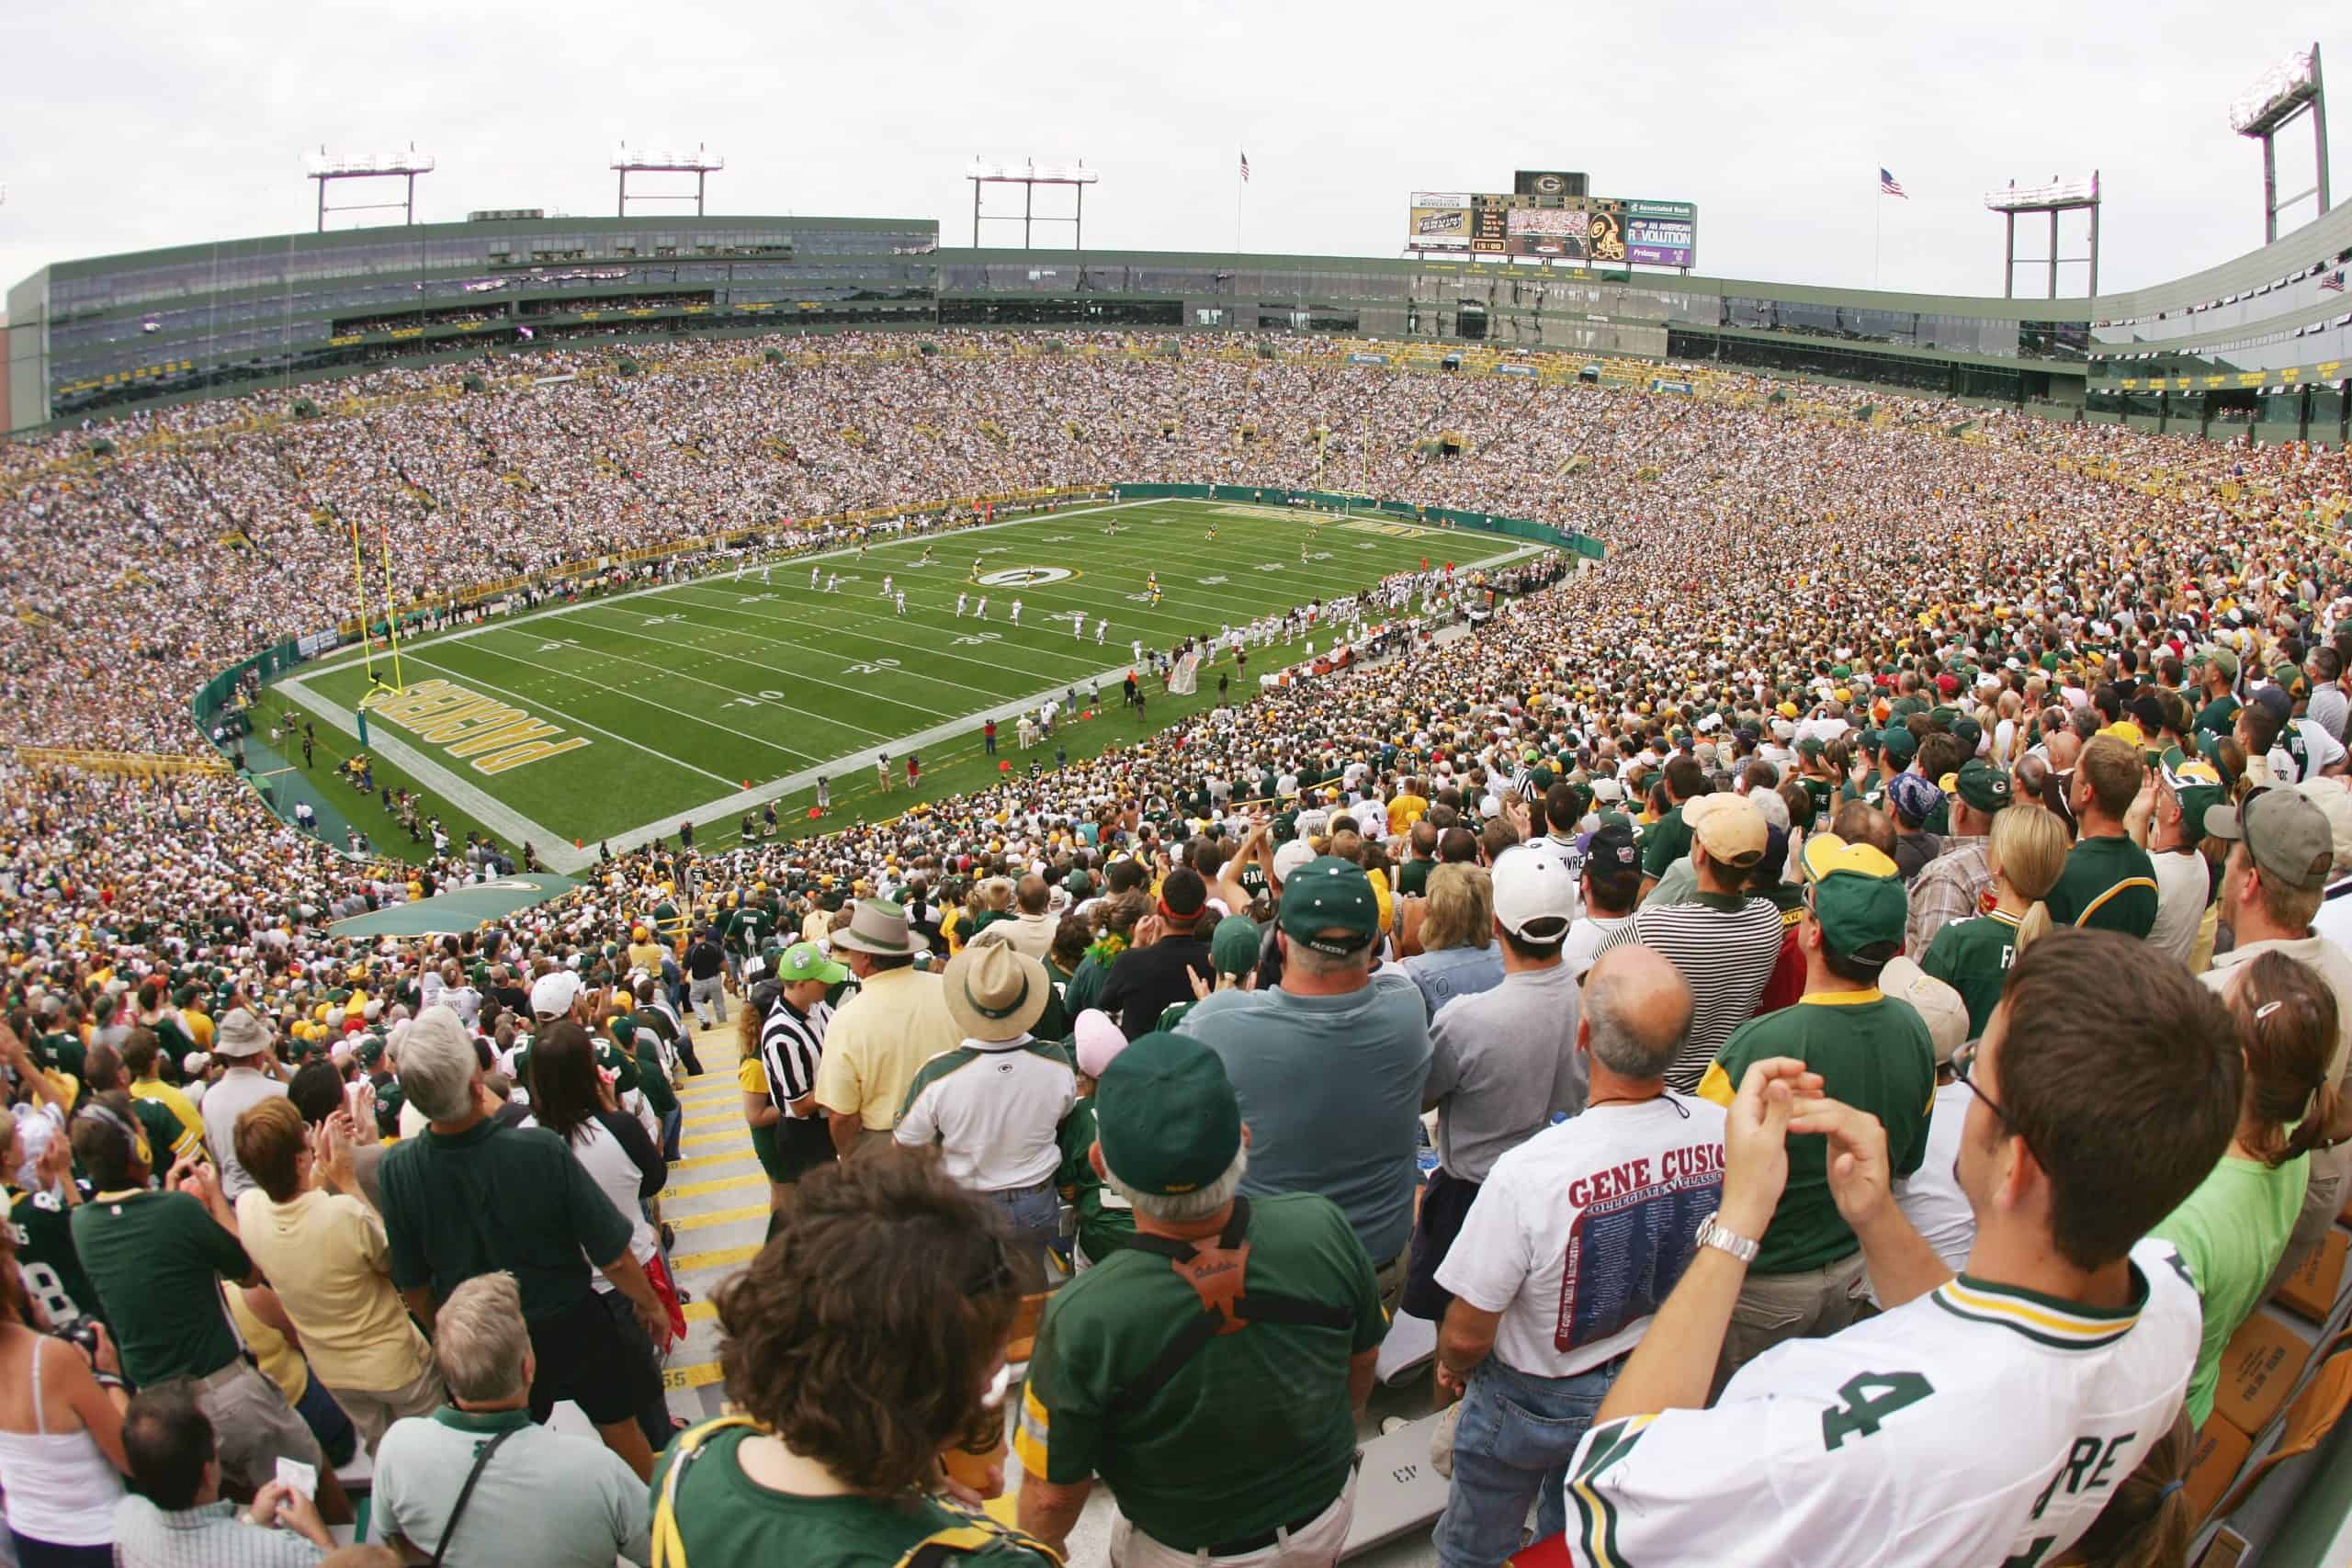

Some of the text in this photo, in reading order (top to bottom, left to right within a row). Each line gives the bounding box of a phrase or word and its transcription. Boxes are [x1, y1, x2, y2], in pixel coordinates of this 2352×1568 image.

[846, 658, 901, 673] 20
[734, 690, 785, 706] 10
[358, 679, 593, 775] PACKERS
[1568, 1157, 1651, 1210] GENE
[1822, 1371, 1936, 1452] 4
